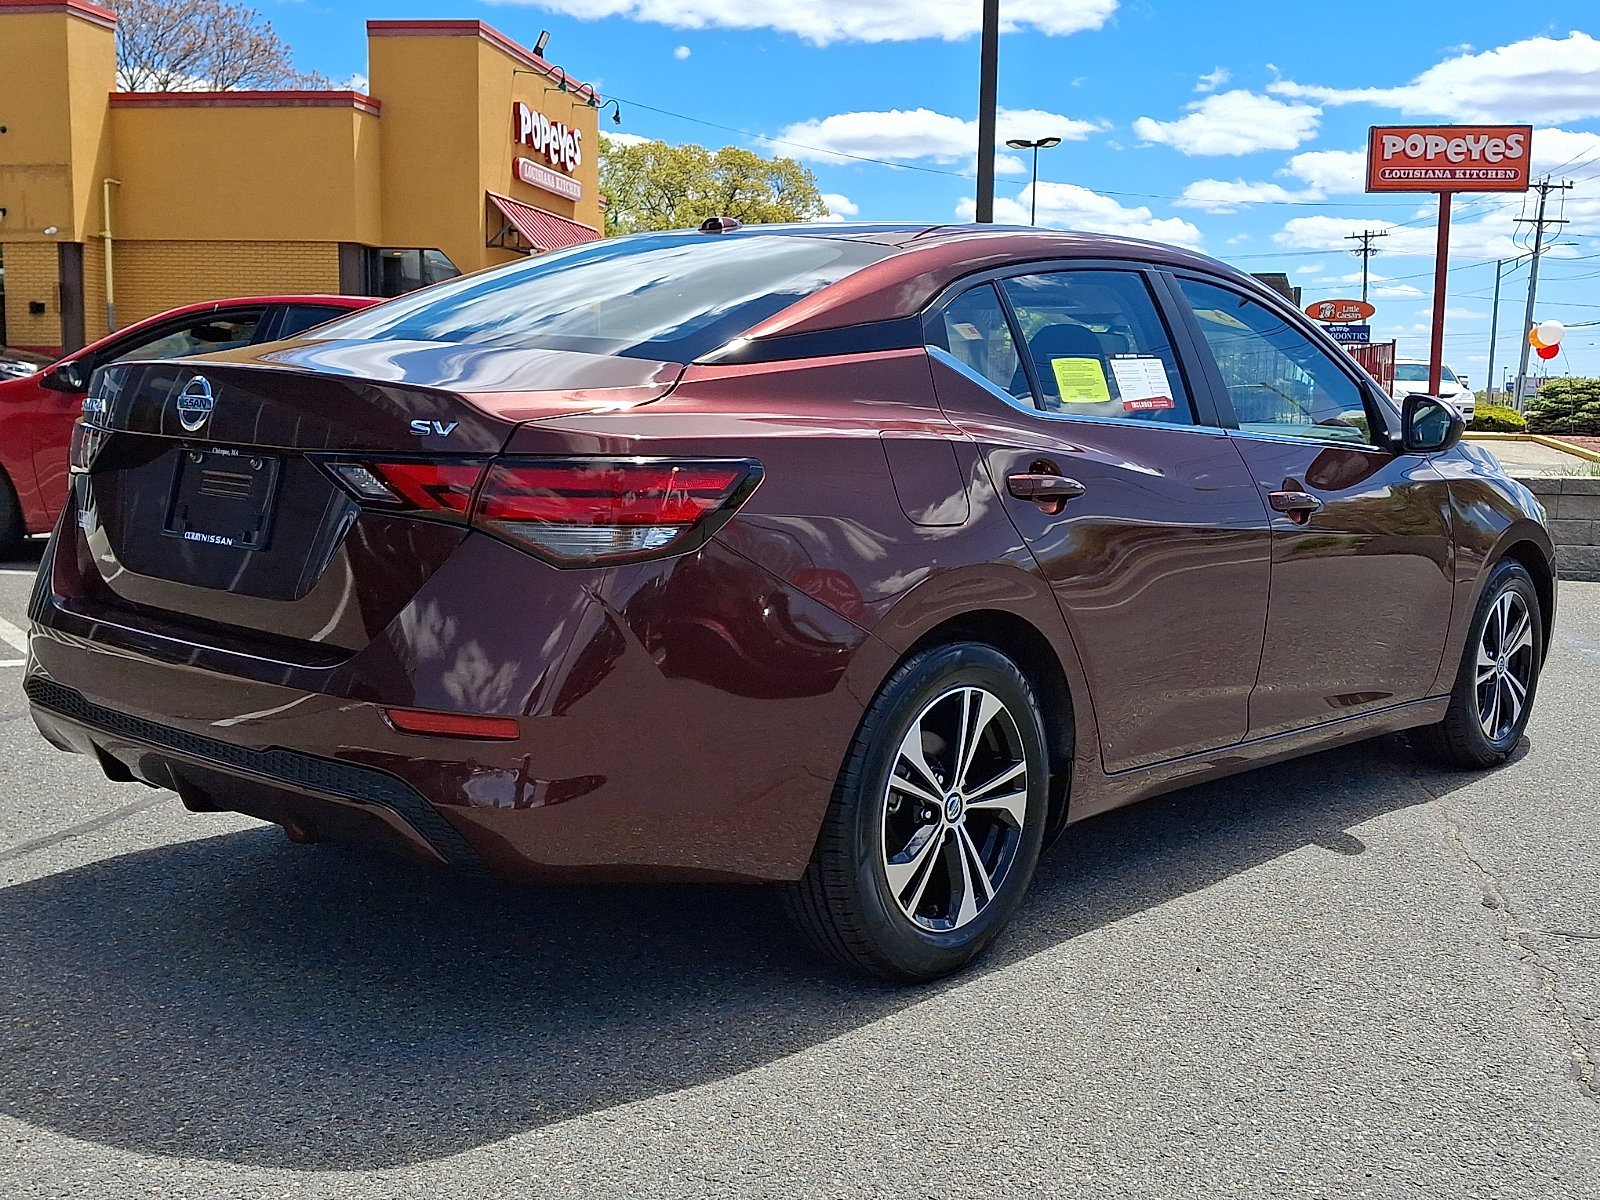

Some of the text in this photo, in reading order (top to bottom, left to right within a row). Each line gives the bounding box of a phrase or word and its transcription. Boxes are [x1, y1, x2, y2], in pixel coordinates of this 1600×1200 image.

[524, 162, 581, 196] LOUISIANA KITCHEN
[1384, 169, 1516, 179] LOUISIANA KITCHEN
[1336, 311, 1362, 319] Caesars
[1329, 332, 1369, 340] ODONTICS
[409, 419, 460, 437] SV
[200, 533, 233, 546] NISSAN
